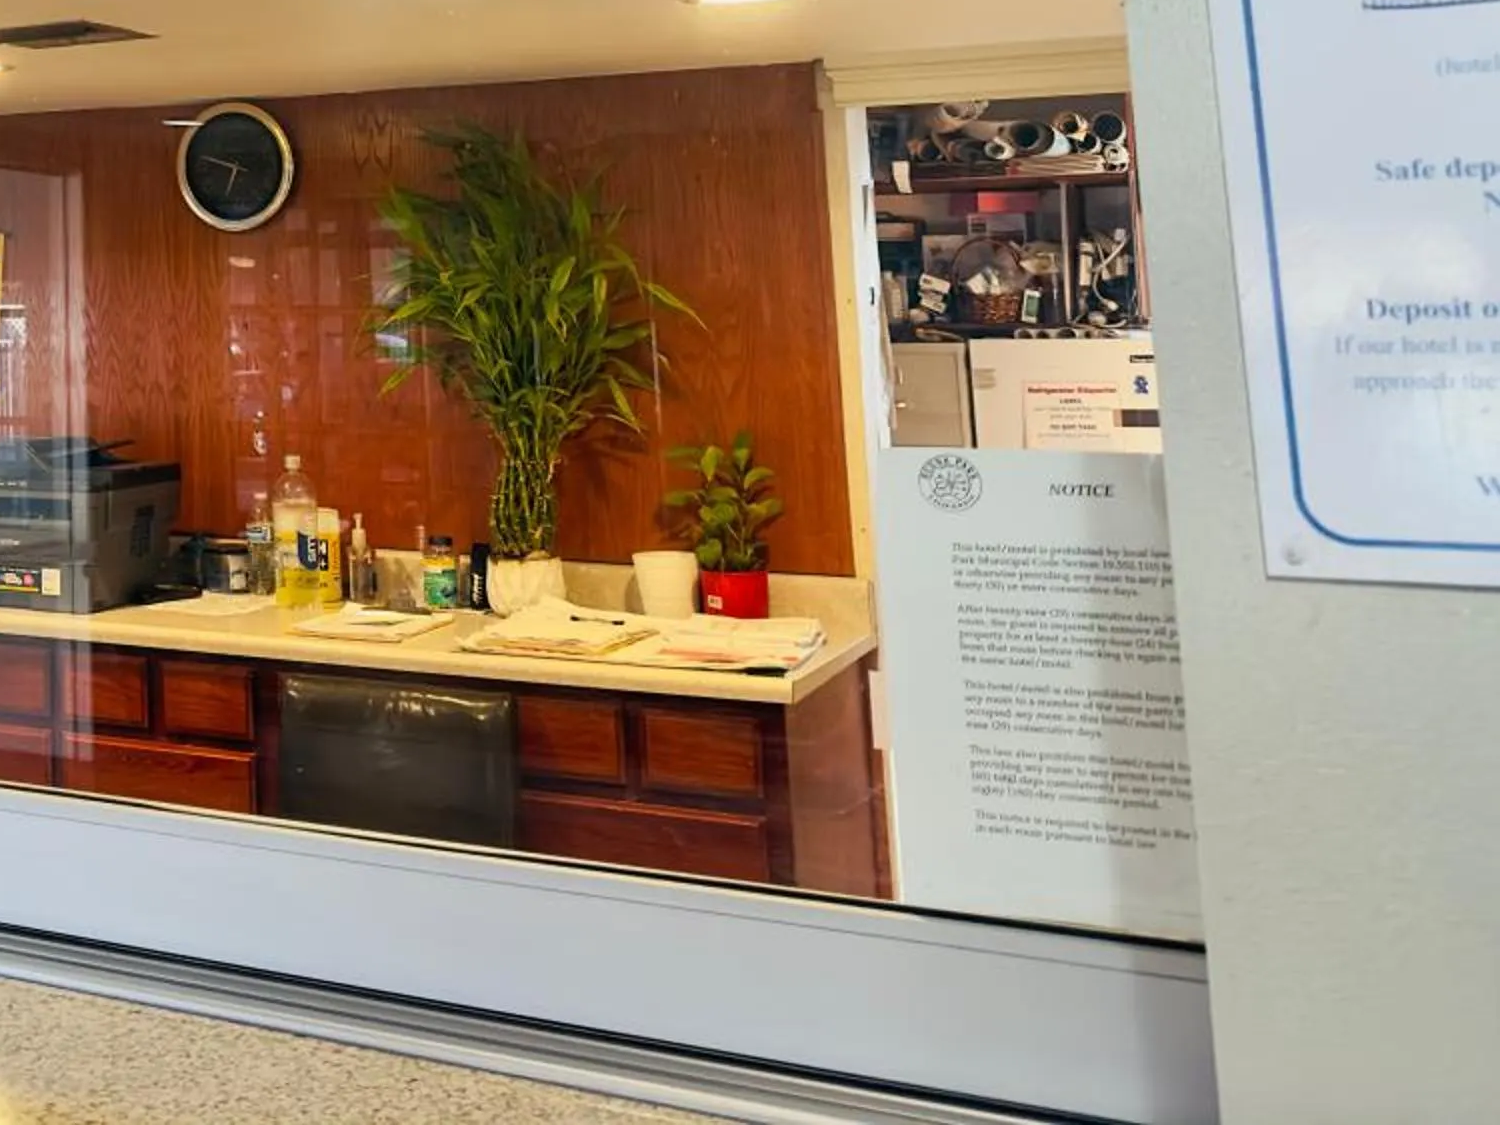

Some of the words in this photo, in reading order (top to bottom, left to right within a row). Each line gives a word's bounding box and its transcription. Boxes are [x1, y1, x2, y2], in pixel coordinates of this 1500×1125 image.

[1374, 158, 1436, 182] Safe
[1365, 295, 1472, 325] Deposit
[1334, 333, 1354, 355] If
[1401, 335, 1458, 355] hotel
[1049, 483, 1114, 498] NOTICE
